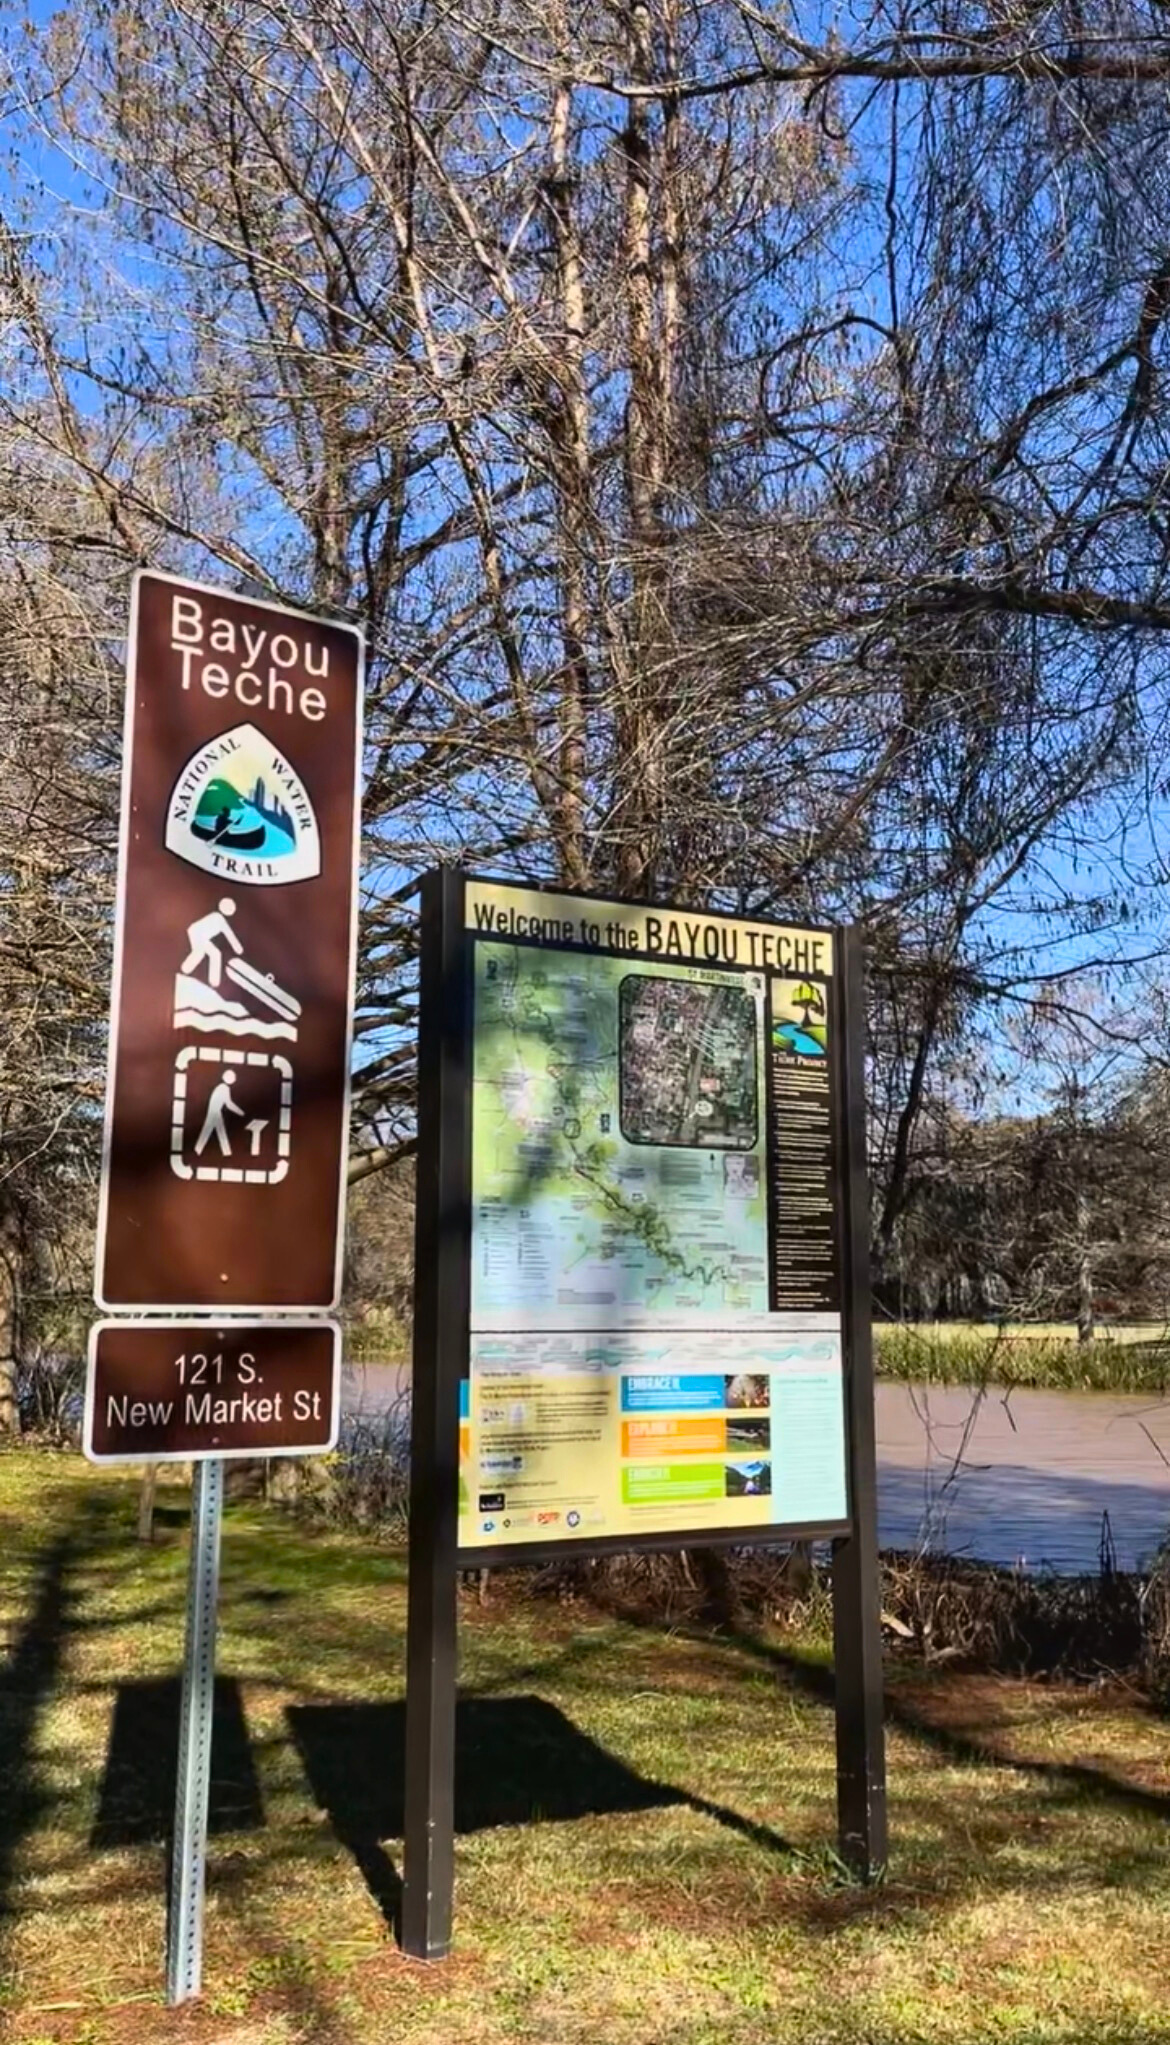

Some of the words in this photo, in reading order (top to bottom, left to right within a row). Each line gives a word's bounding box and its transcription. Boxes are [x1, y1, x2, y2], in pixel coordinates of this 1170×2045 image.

[171, 595, 330, 678] Bayou
[171, 642, 328, 721] Teche
[173, 737, 242, 823] NATIONAL
[271, 757, 313, 832] WATER
[211, 852, 279, 878] TRAIL
[473, 902, 574, 943] Welcome
[579, 918, 601, 946] to
[606, 922, 641, 951] the
[645, 916, 738, 964] BAYOU
[745, 931, 826, 975] TECHE
[174, 1353, 223, 1386] 121
[236, 1352, 264, 1384] S.
[106, 1394, 174, 1428] New
[184, 1391, 283, 1425] Market
[292, 1390, 322, 1421] St
